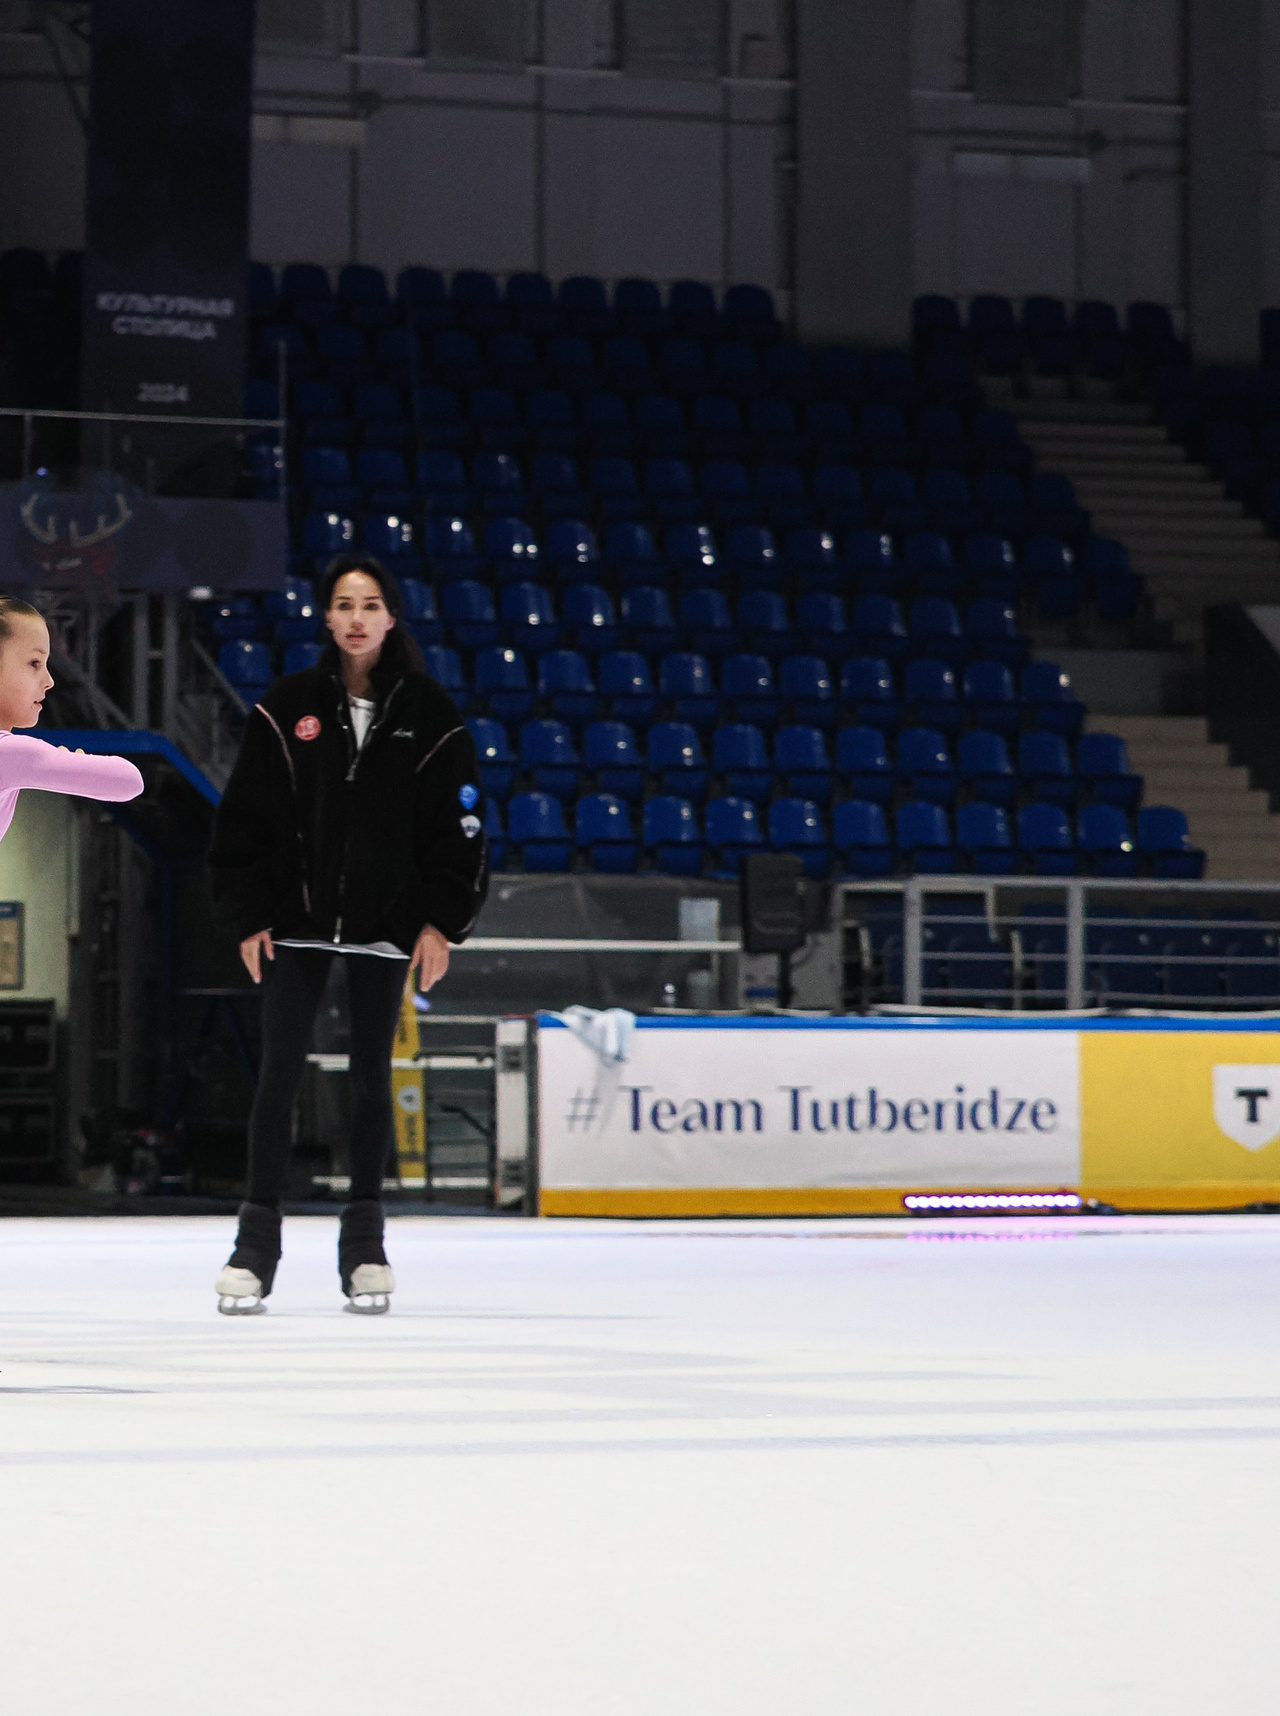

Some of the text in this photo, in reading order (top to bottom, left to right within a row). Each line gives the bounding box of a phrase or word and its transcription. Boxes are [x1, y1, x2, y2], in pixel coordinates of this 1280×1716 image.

[96, 292, 236, 318] КУЛЬТУРНАЯ
[111, 315, 218, 340] СТОЛИЦА
[617, 1084, 763, 1132] Team
[776, 1082, 1059, 1133] Tutberidze
[1235, 1086, 1269, 1123] T
